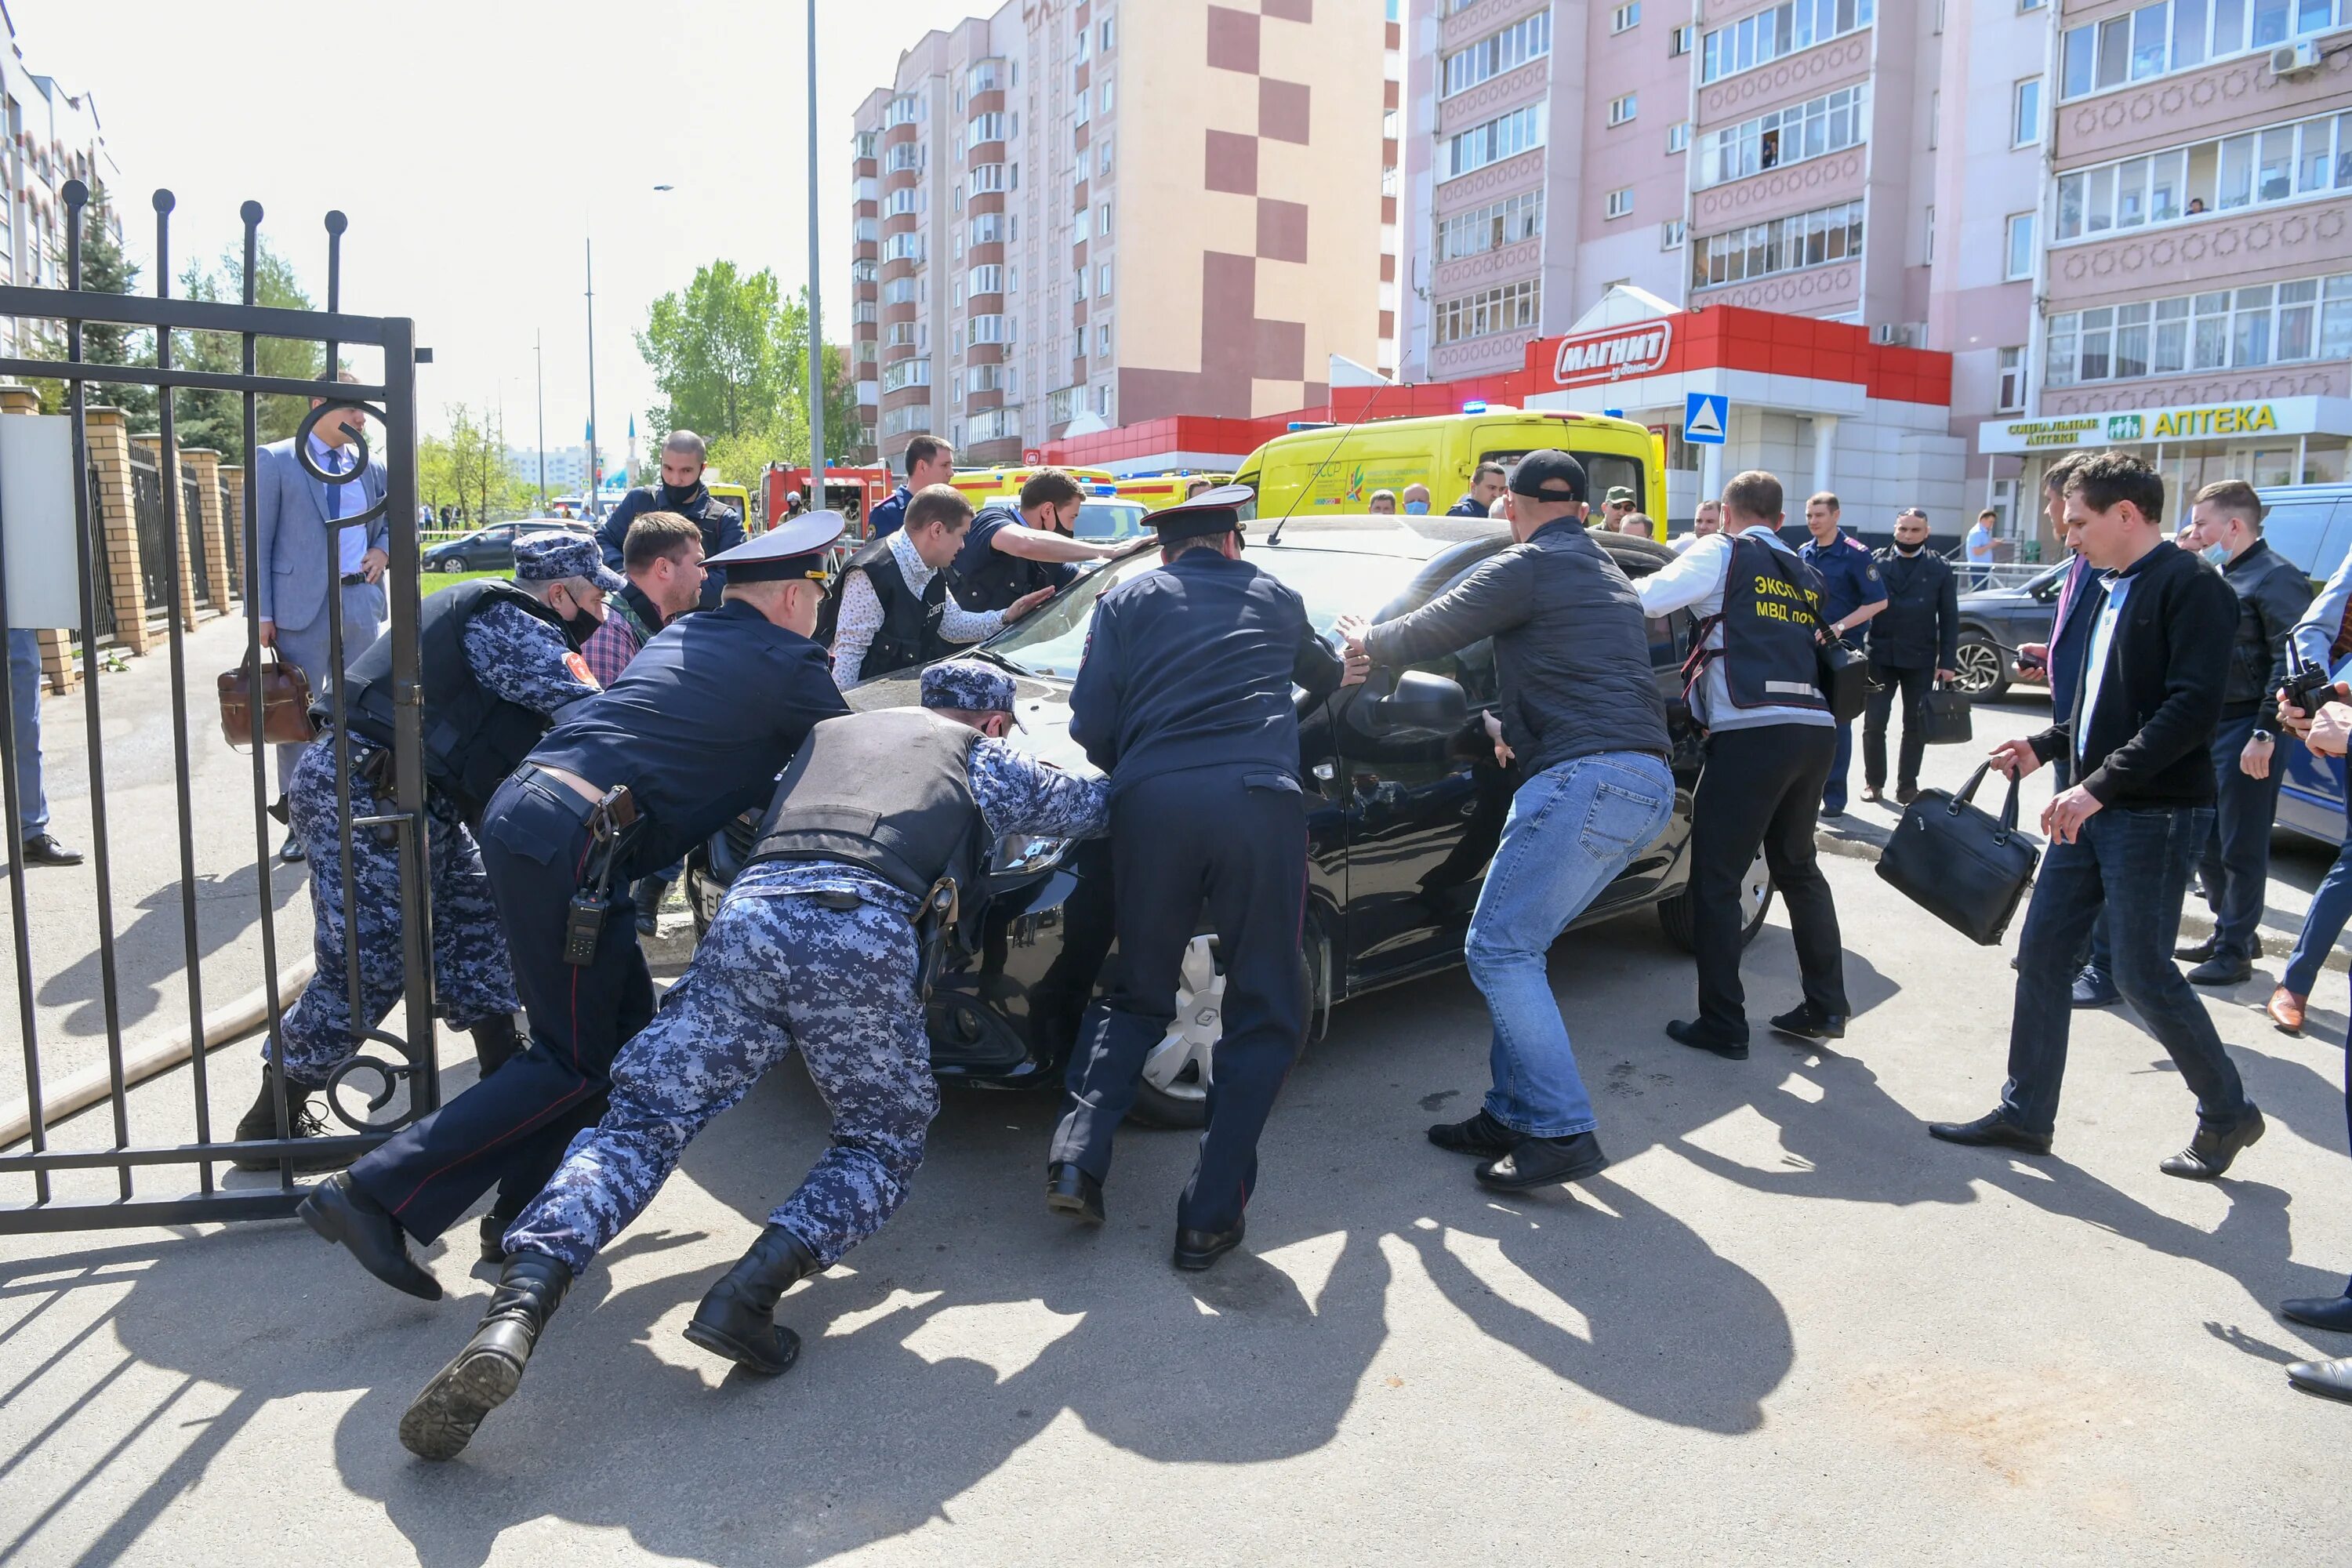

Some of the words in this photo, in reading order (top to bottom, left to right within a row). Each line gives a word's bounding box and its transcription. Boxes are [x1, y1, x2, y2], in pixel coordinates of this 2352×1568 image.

[1561, 332, 1664, 372] МАГНИТ
[2009, 418, 2100, 434] СОЦИАЛЬНЫЕ
[2154, 405, 2277, 437] АПТЕКА
[2026, 432, 2079, 445] АПТЕКИ
[1756, 601, 1789, 622] МВД
